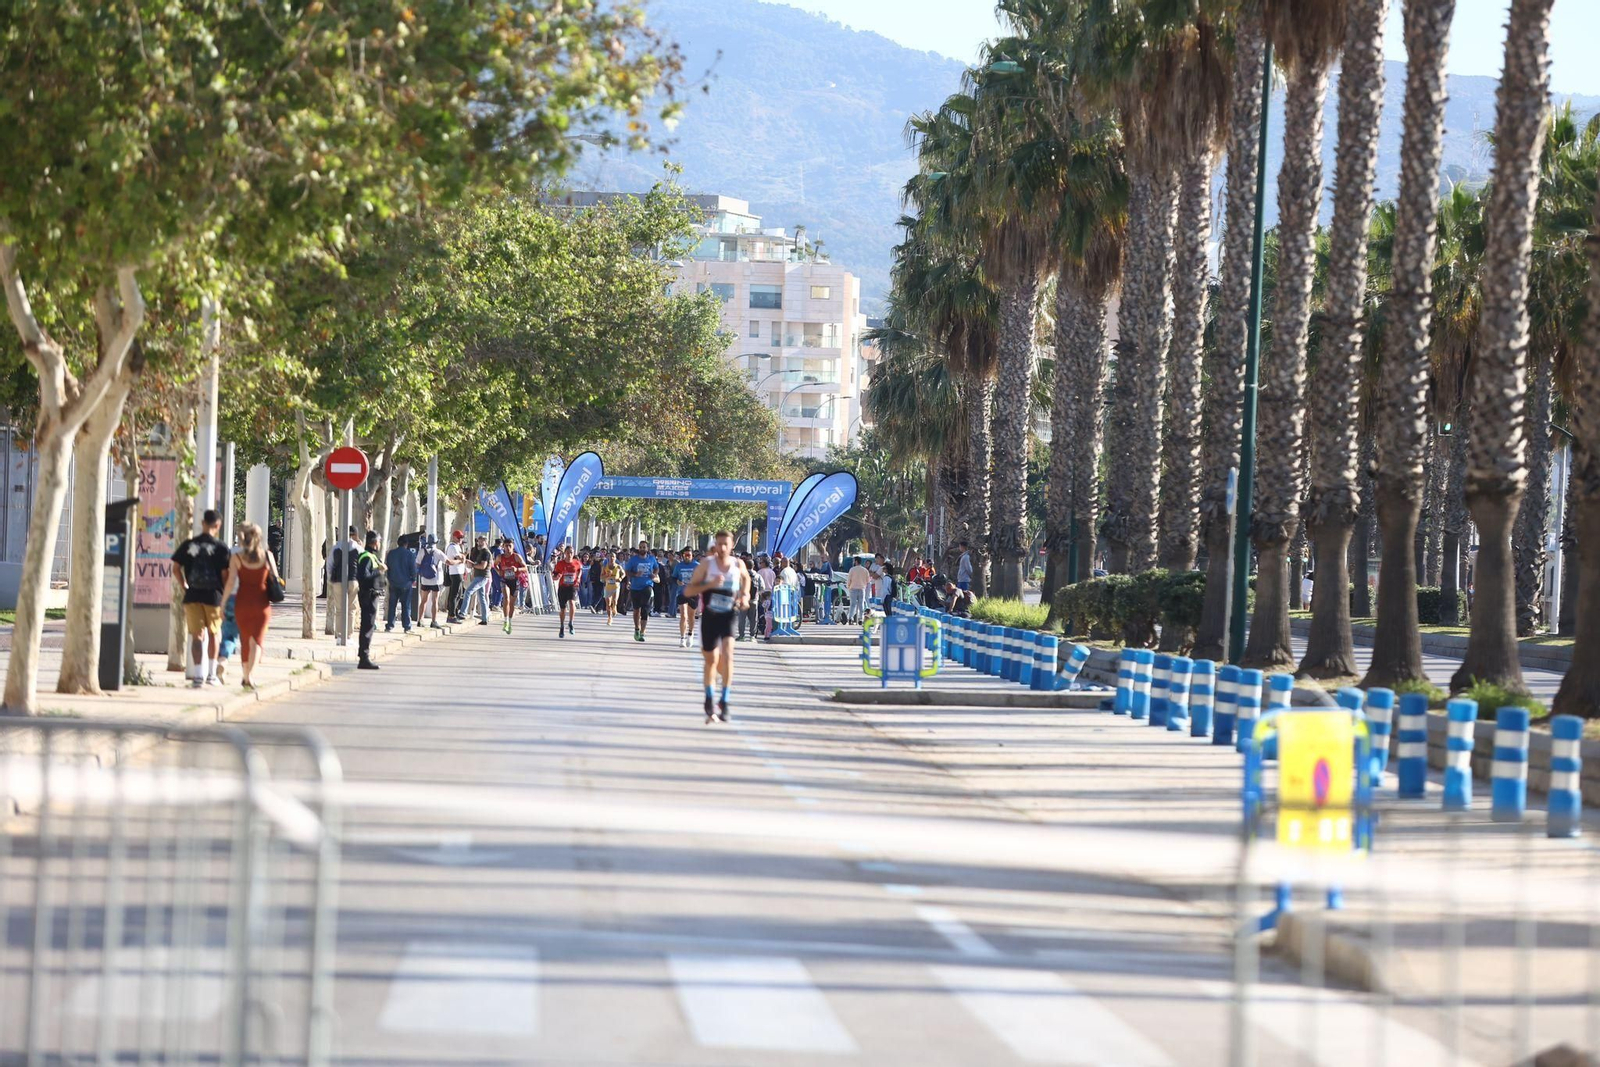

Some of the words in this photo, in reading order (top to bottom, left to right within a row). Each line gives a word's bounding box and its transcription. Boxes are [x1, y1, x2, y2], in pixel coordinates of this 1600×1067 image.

[557, 467, 592, 523] mayoral
[733, 485, 783, 496] mayoral
[793, 487, 845, 538] mayoral
[106, 534, 119, 552] P
[137, 562, 172, 578] VTM
